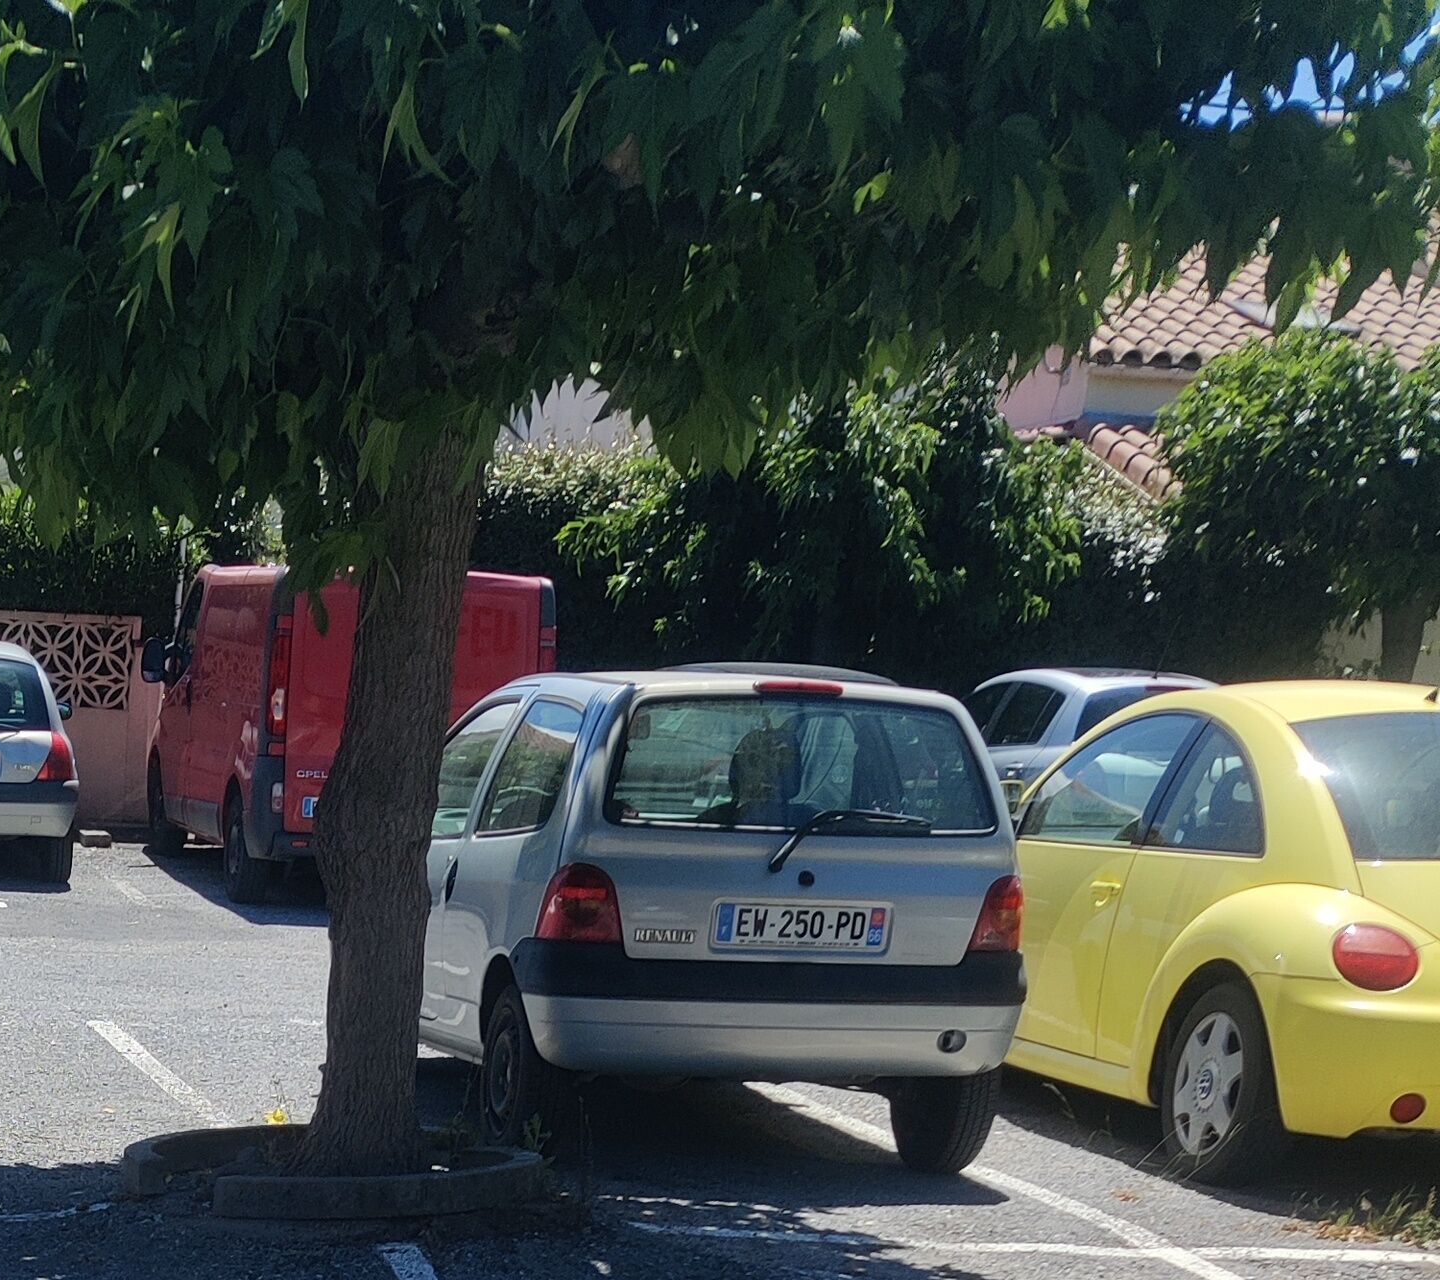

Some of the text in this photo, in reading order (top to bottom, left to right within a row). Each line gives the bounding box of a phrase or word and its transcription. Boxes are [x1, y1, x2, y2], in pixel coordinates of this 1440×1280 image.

[296, 769, 329, 779] OPEL
[735, 908, 867, 940] EW-250-PD
[634, 928, 697, 944] RENAULT
[868, 928, 883, 943] 66
